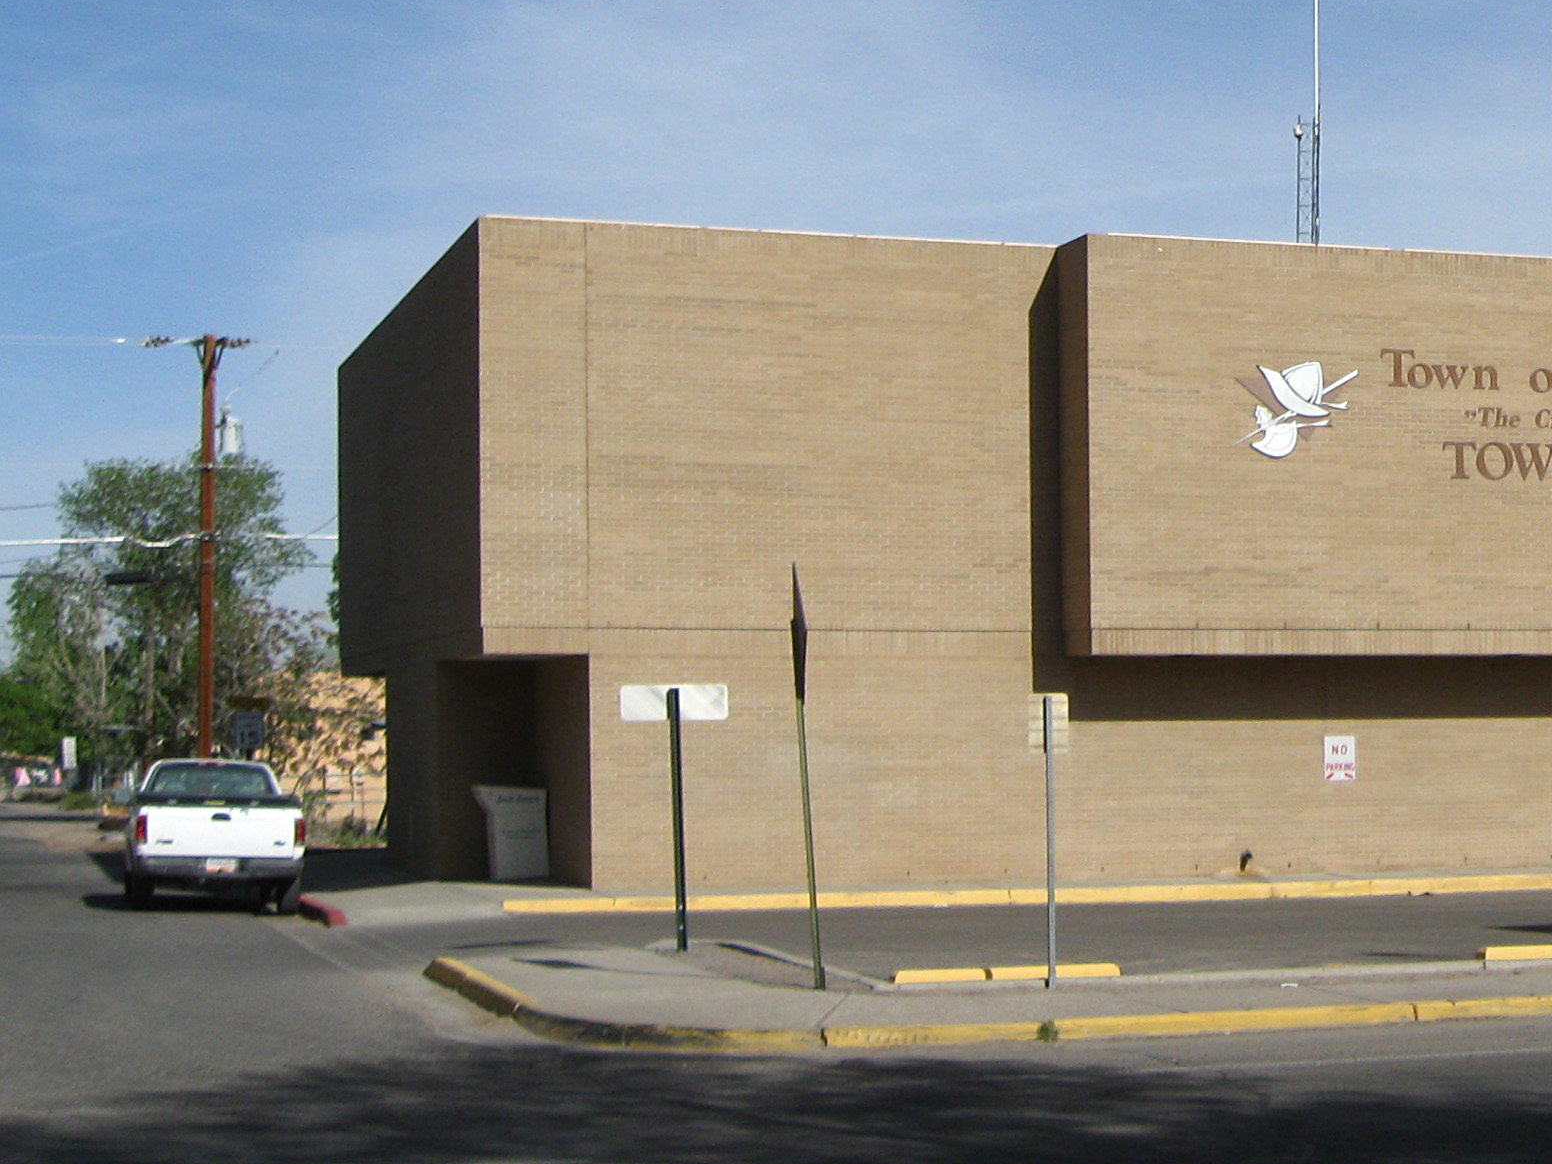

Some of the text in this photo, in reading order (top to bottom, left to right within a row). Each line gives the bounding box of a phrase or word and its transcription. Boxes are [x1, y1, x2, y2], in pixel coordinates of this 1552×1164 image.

[1380, 348, 1499, 390] Town
[1332, 745, 1347, 755] NO
[1326, 763, 1355, 771] PARKING
